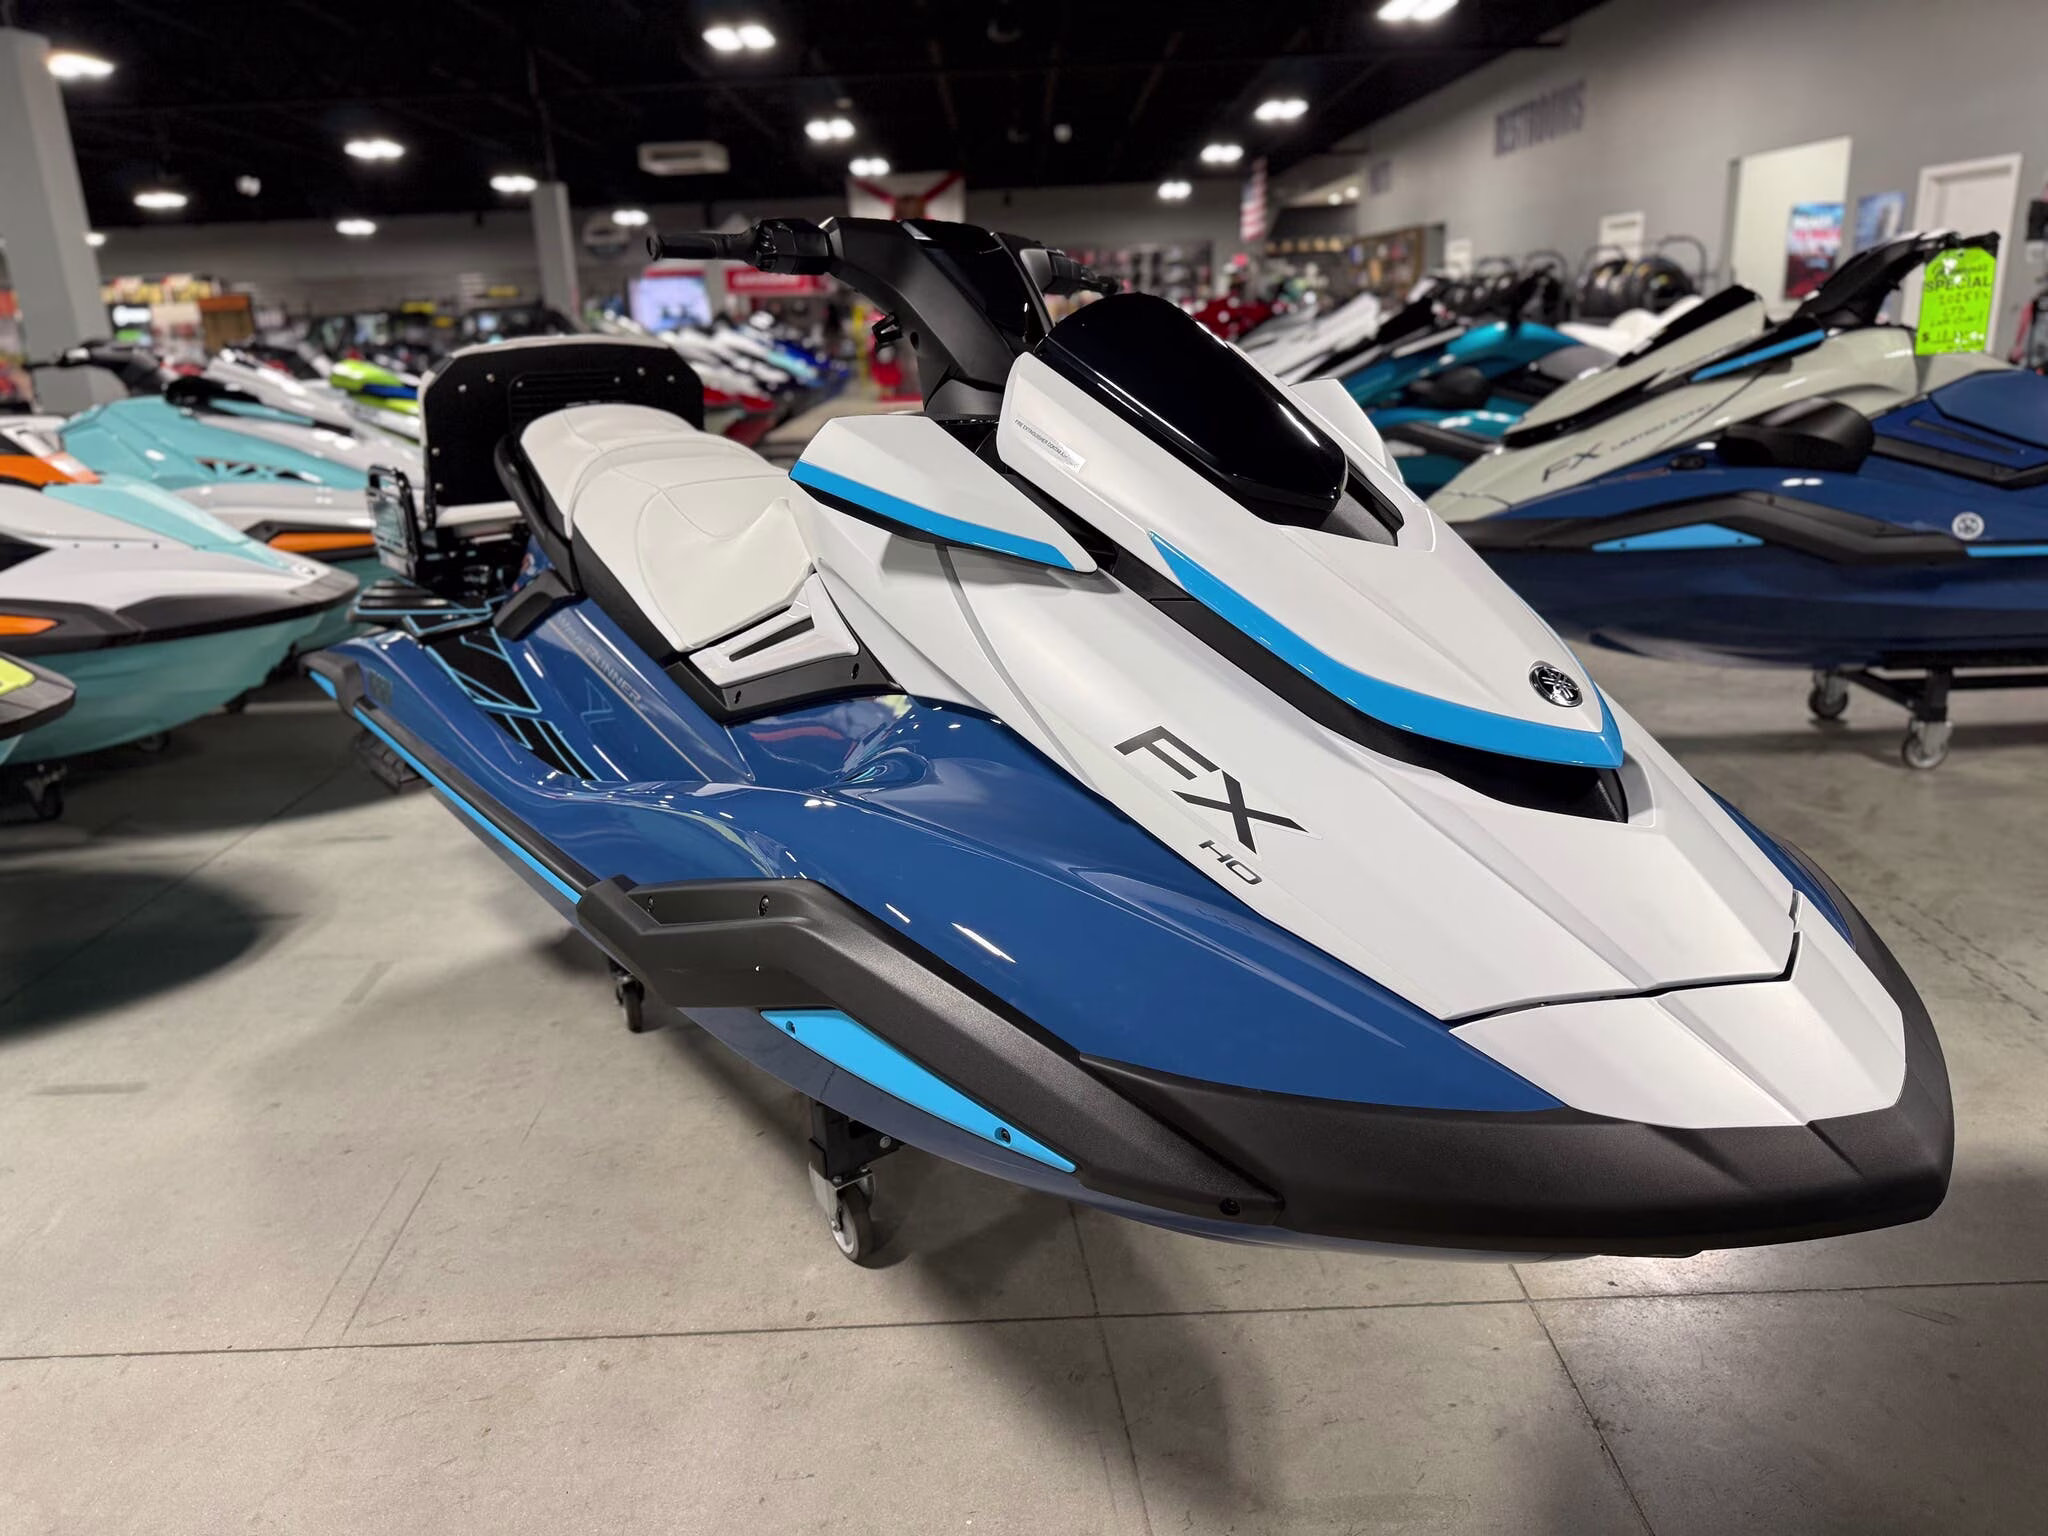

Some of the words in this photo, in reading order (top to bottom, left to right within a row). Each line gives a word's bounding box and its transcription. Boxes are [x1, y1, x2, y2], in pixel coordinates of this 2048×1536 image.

[1924, 276, 1990, 292] SPECIAL
[1542, 441, 1603, 483] FX
[1113, 725, 1310, 855] FX
[1198, 840, 1262, 885] HO
